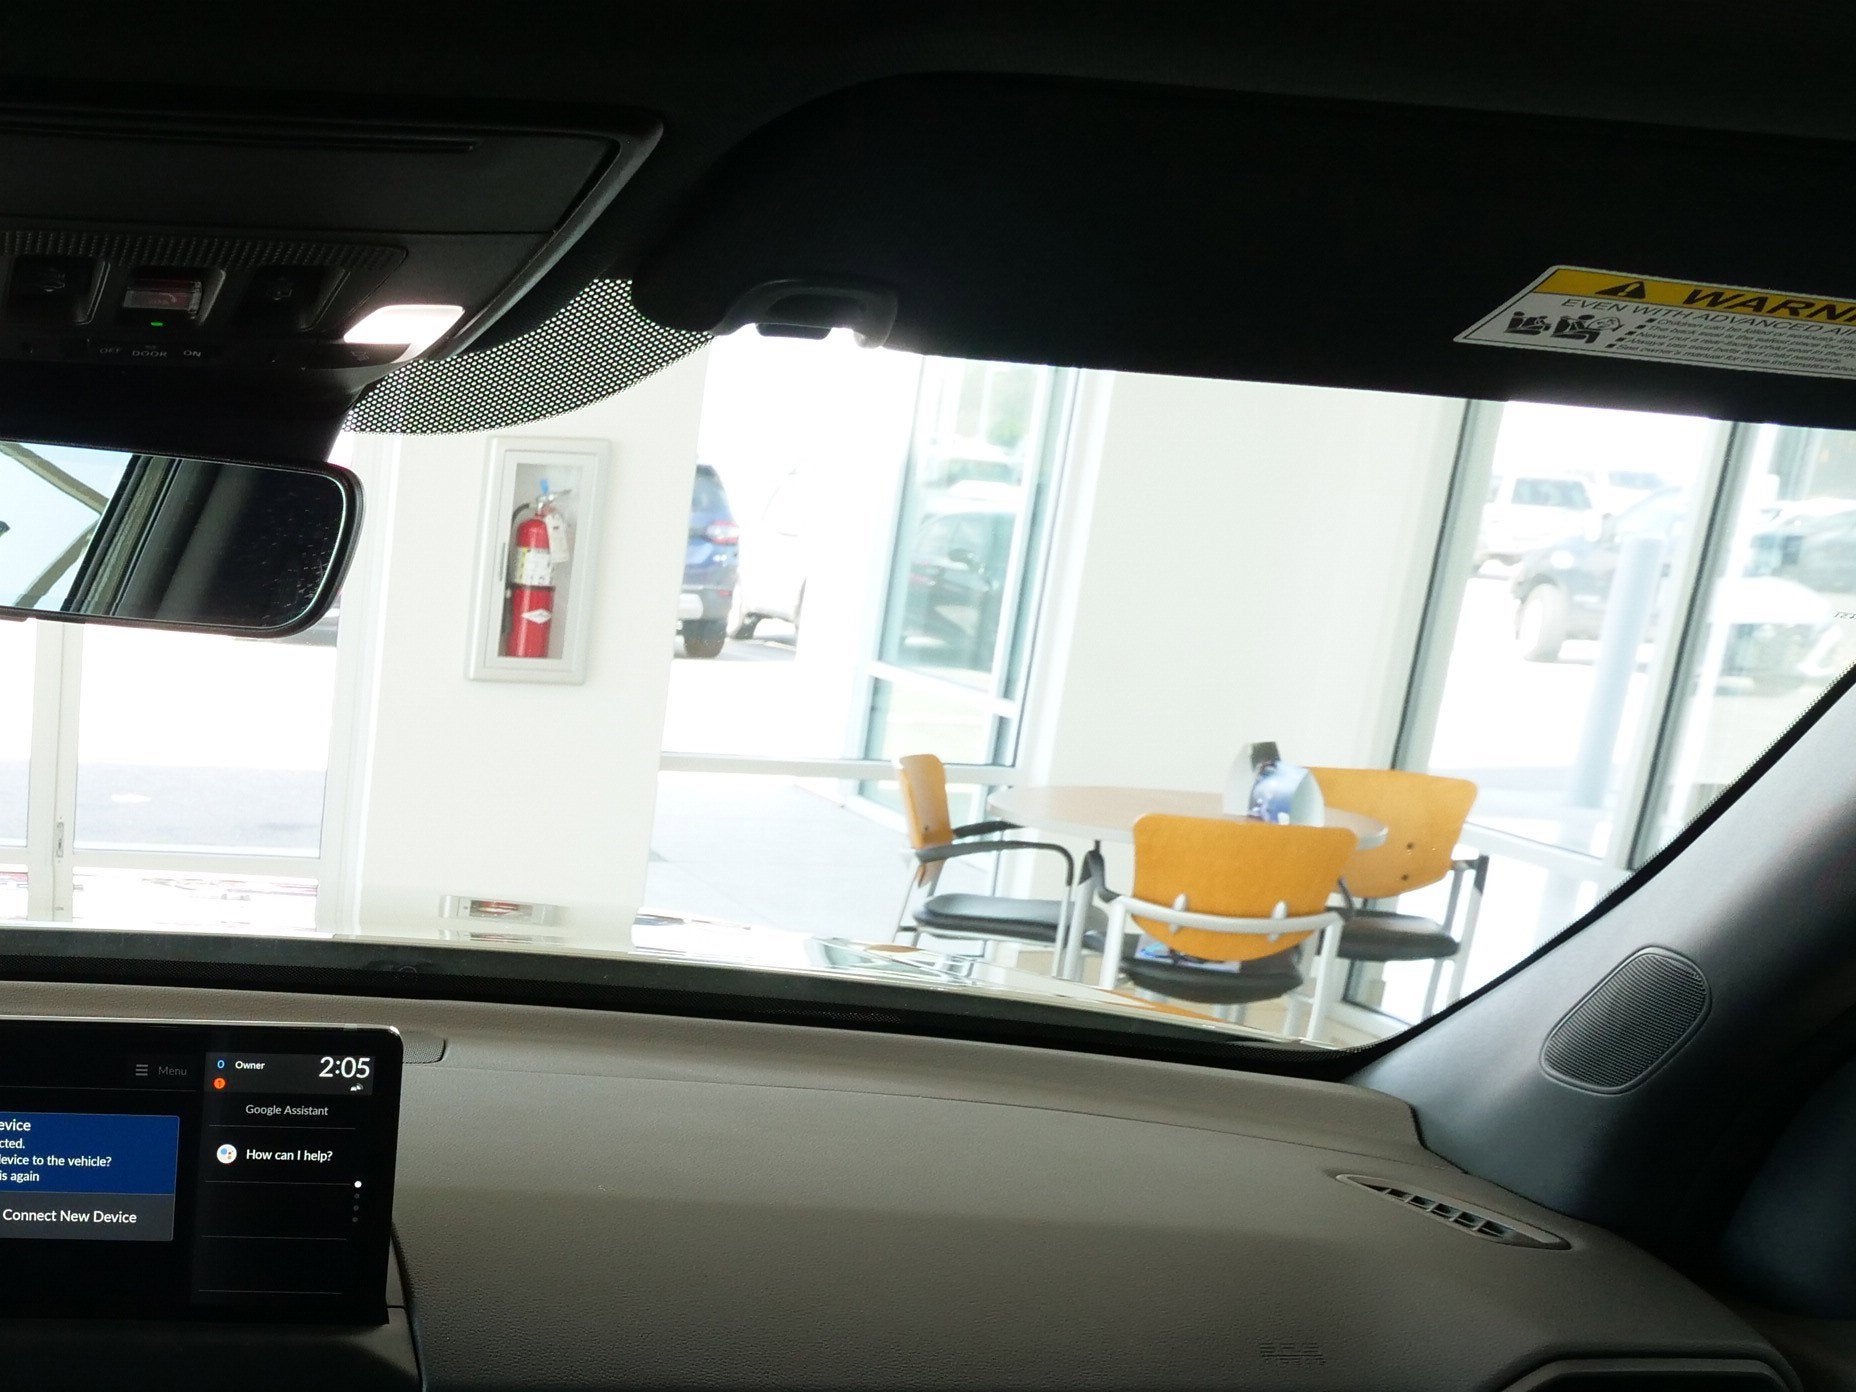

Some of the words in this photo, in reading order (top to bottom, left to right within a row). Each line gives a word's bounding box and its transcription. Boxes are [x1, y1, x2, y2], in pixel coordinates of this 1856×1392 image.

[1682, 289, 1856, 322] WARN
[1562, 299, 1628, 311] EVEN
[1633, 306, 1693, 318] WITH
[1694, 314, 1824, 332] ADVANCED
[132, 350, 167, 358] DOOR
[158, 1066, 187, 1075] Menu
[235, 1061, 265, 1069] Owner
[319, 1056, 370, 1078] 2:05
[245, 1104, 282, 1116] Google
[283, 1105, 328, 1115] Assistant
[32, 1155, 44, 1165] to
[46, 1155, 65, 1166] the
[67, 1155, 112, 1166] vehicle?
[246, 1149, 272, 1160] How
[274, 1152, 294, 1160] can
[297, 1150, 301, 1160] I
[303, 1150, 333, 1163] help?
[10, 1170, 39, 1183] again
[2, 1208, 57, 1221] Connect
[60, 1210, 90, 1222] New
[93, 1210, 137, 1223] Device
